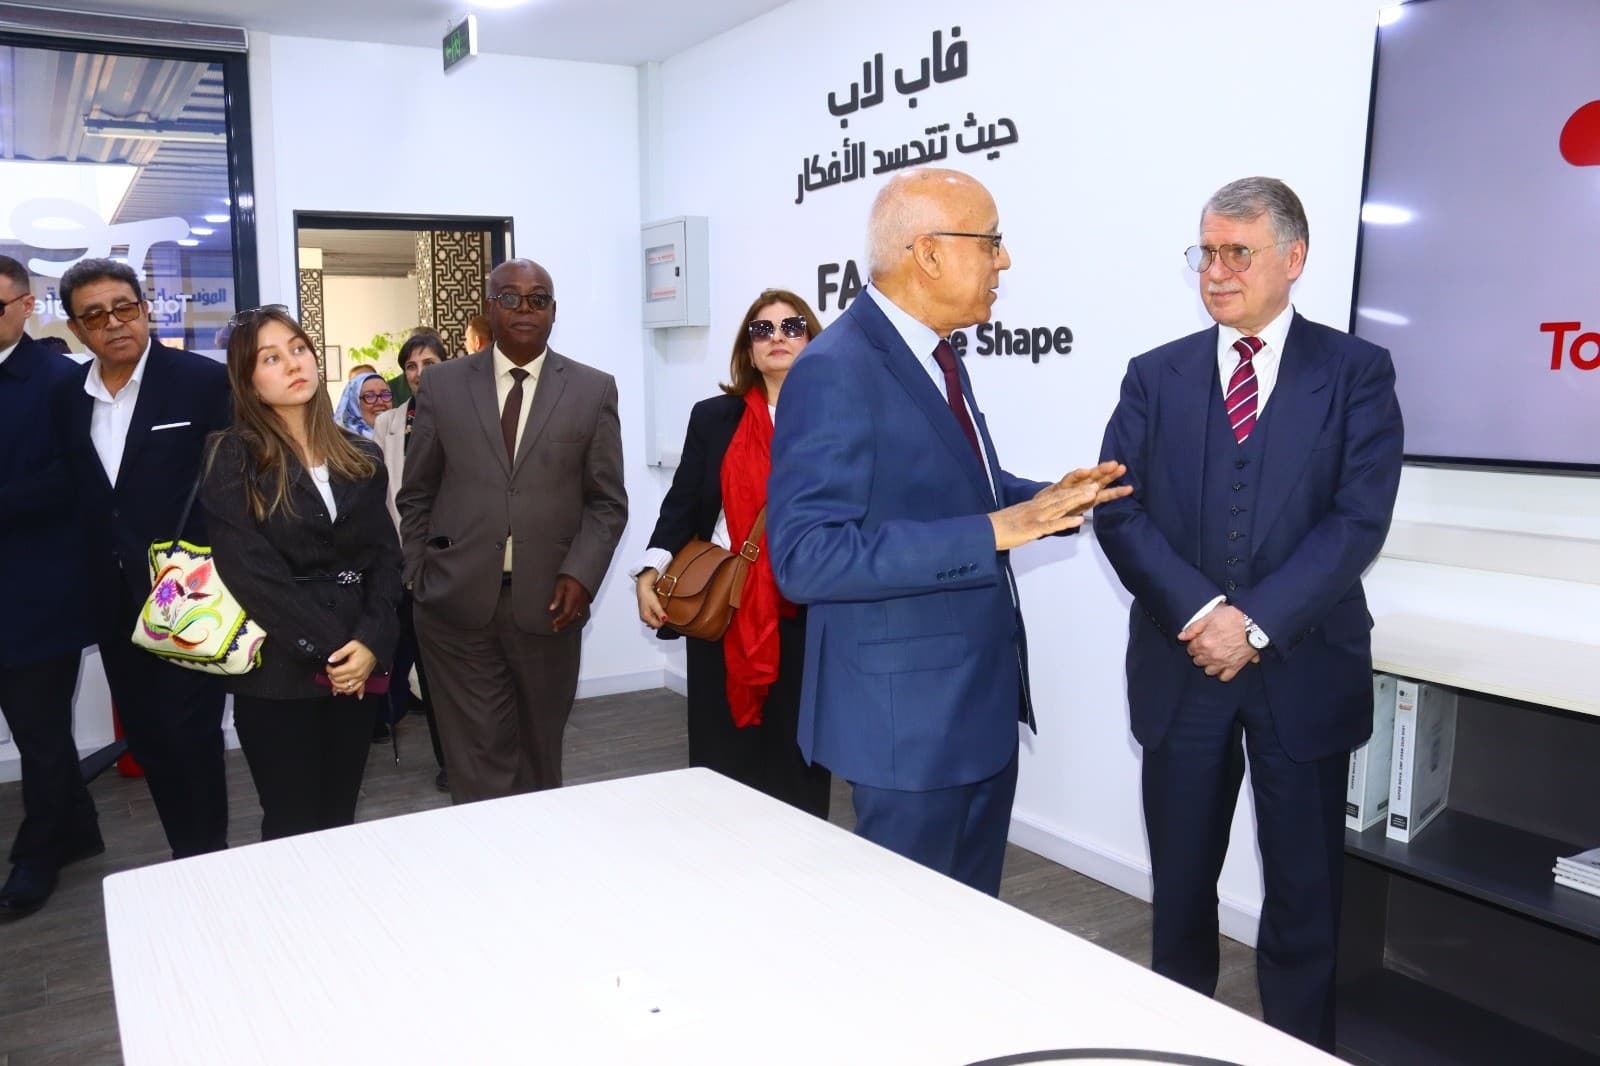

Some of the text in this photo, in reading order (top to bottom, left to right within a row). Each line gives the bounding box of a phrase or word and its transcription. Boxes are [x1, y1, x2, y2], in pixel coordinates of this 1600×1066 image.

[828, 26, 968, 129] فاب لاب
[956, 112, 1019, 161] حيث
[795, 138, 865, 205] الأفكار
[818, 259, 869, 312] FA
[976, 321, 1074, 364] Shape
